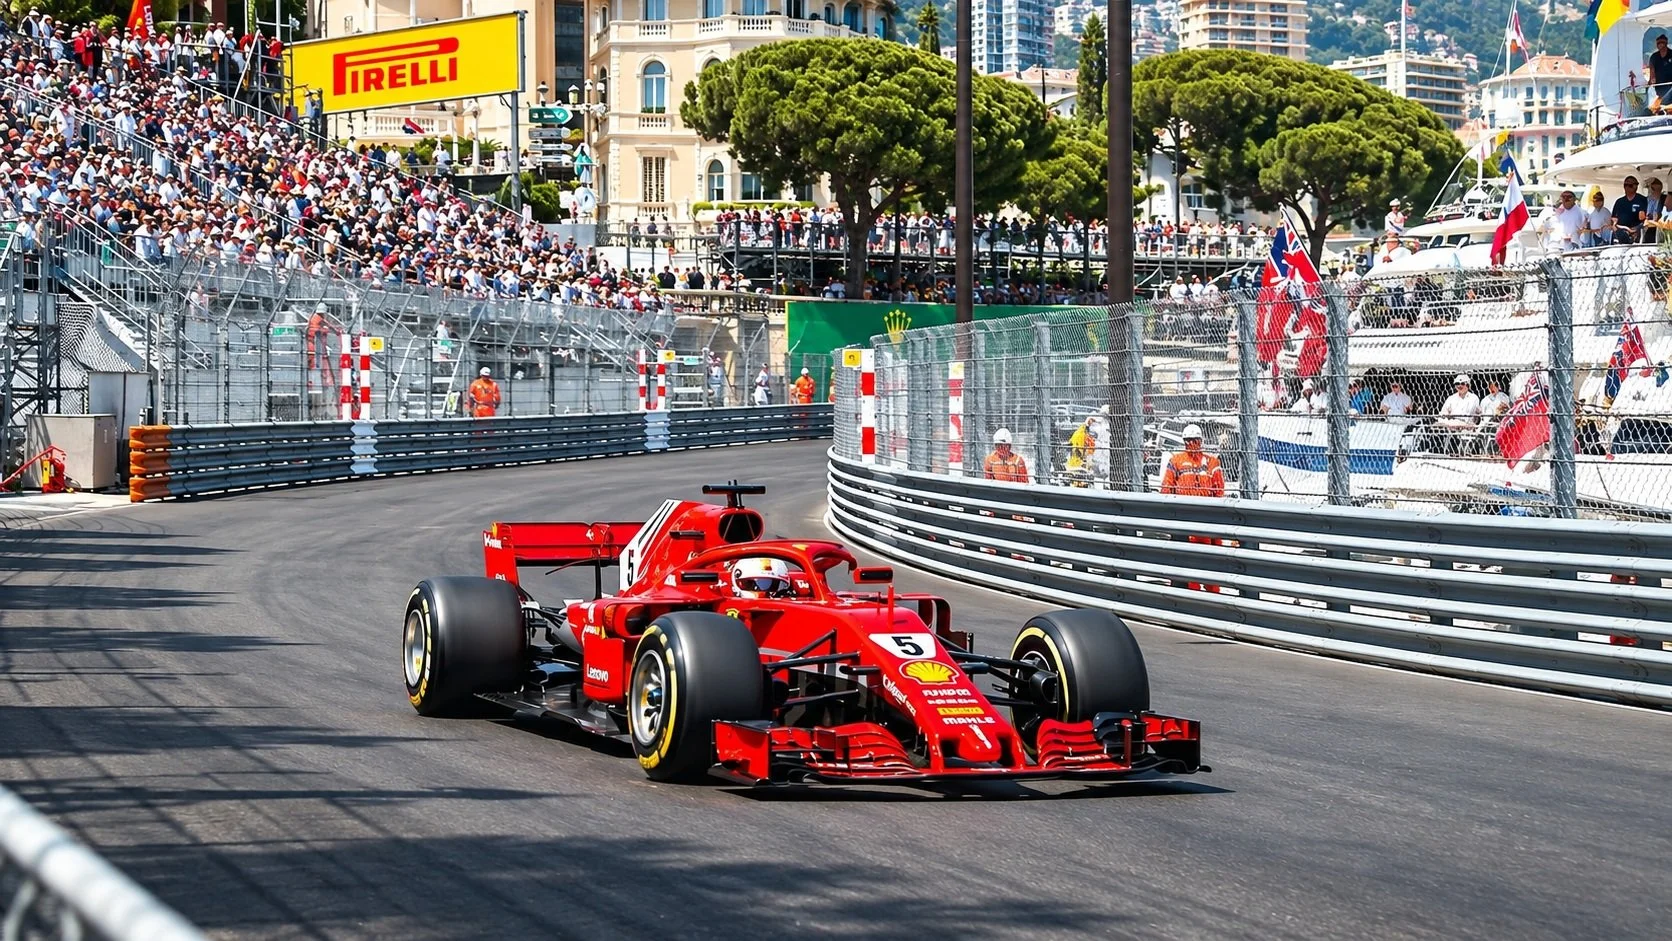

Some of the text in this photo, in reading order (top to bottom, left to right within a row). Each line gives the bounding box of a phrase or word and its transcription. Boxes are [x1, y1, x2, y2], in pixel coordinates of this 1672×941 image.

[333, 37, 459, 96] PIRELLI
[627, 549, 635, 587] 5
[891, 635, 925, 656] 5
